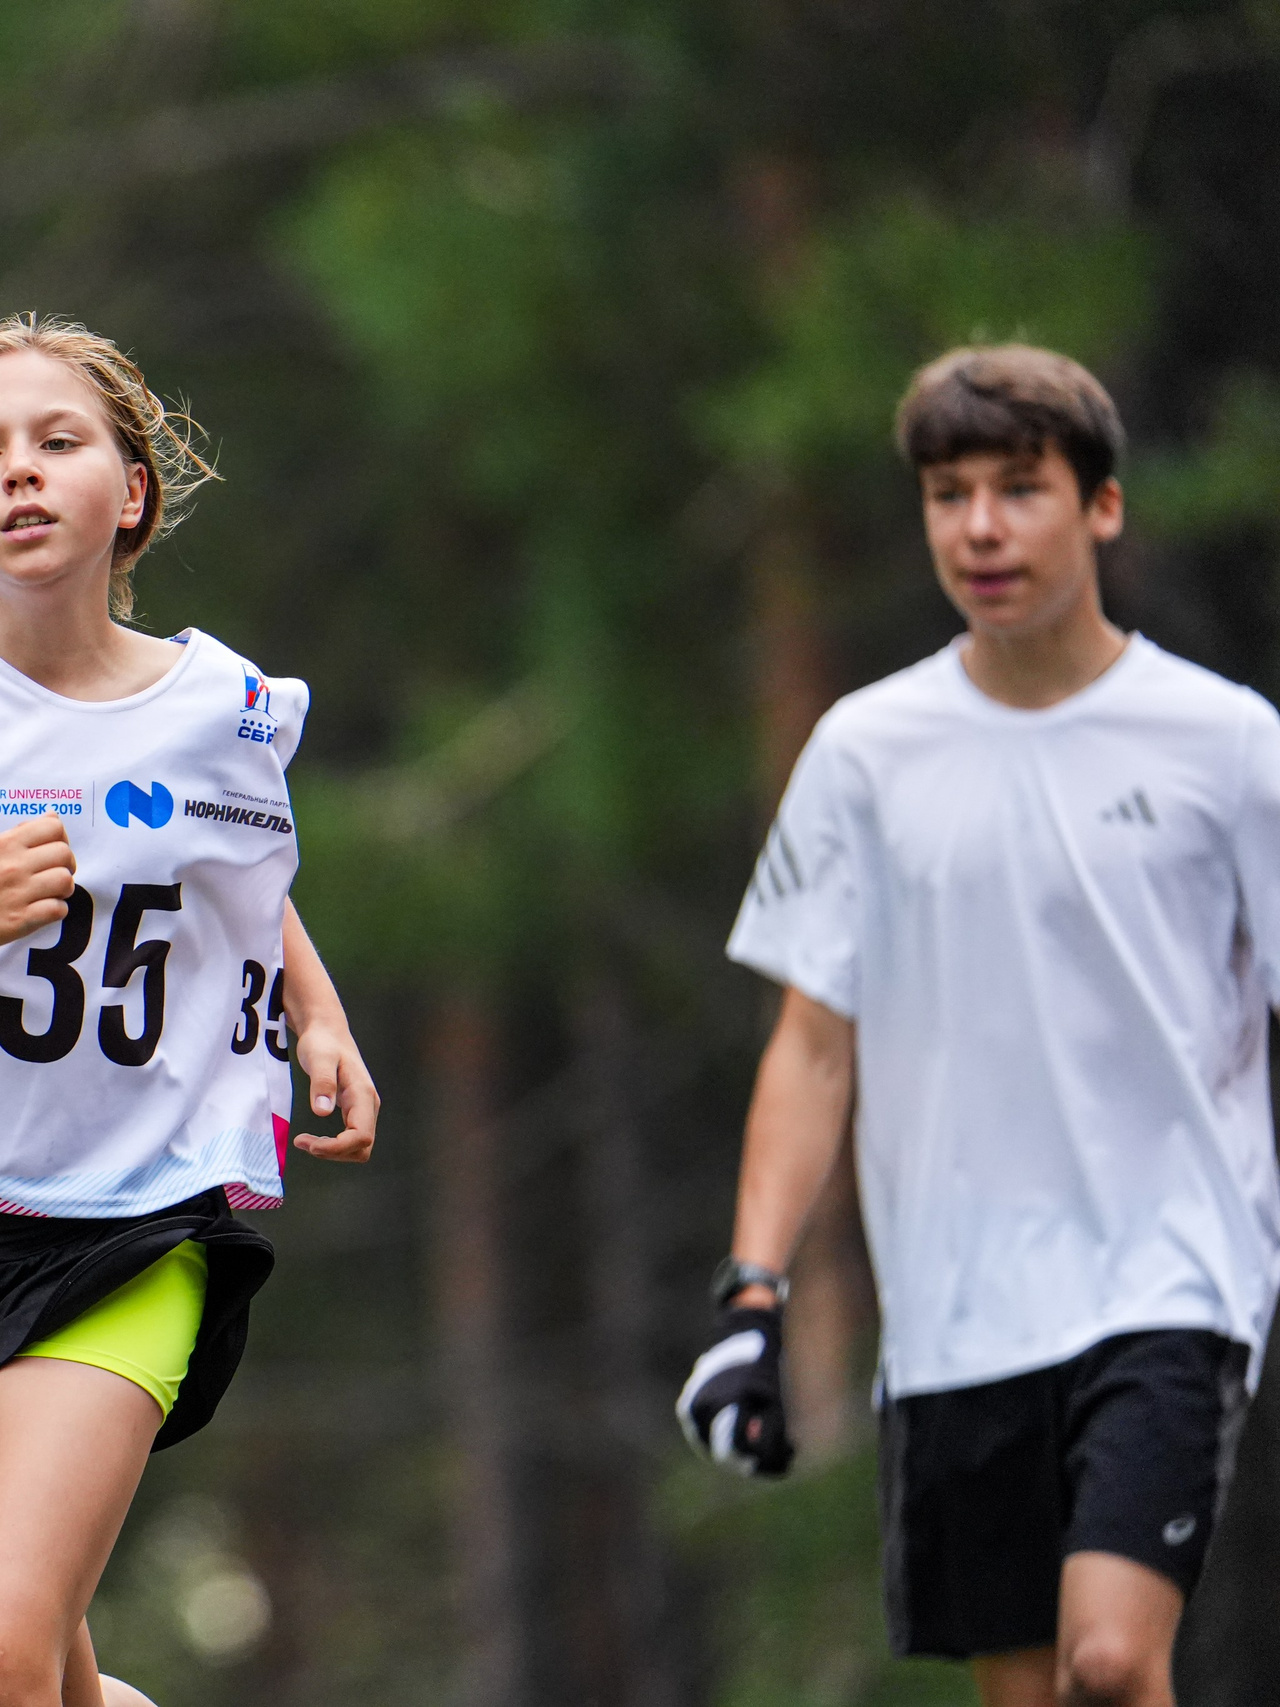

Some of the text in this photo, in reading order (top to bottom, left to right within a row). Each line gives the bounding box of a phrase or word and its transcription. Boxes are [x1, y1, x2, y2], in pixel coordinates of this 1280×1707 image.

[8, 789, 82, 799] UNIVERSIADE
[222, 789, 268, 804] ГЕНЕРАЛЬНЫЙ
[51, 803, 82, 815] 2019
[184, 799, 293, 834] НОРНИКЕЛЬ
